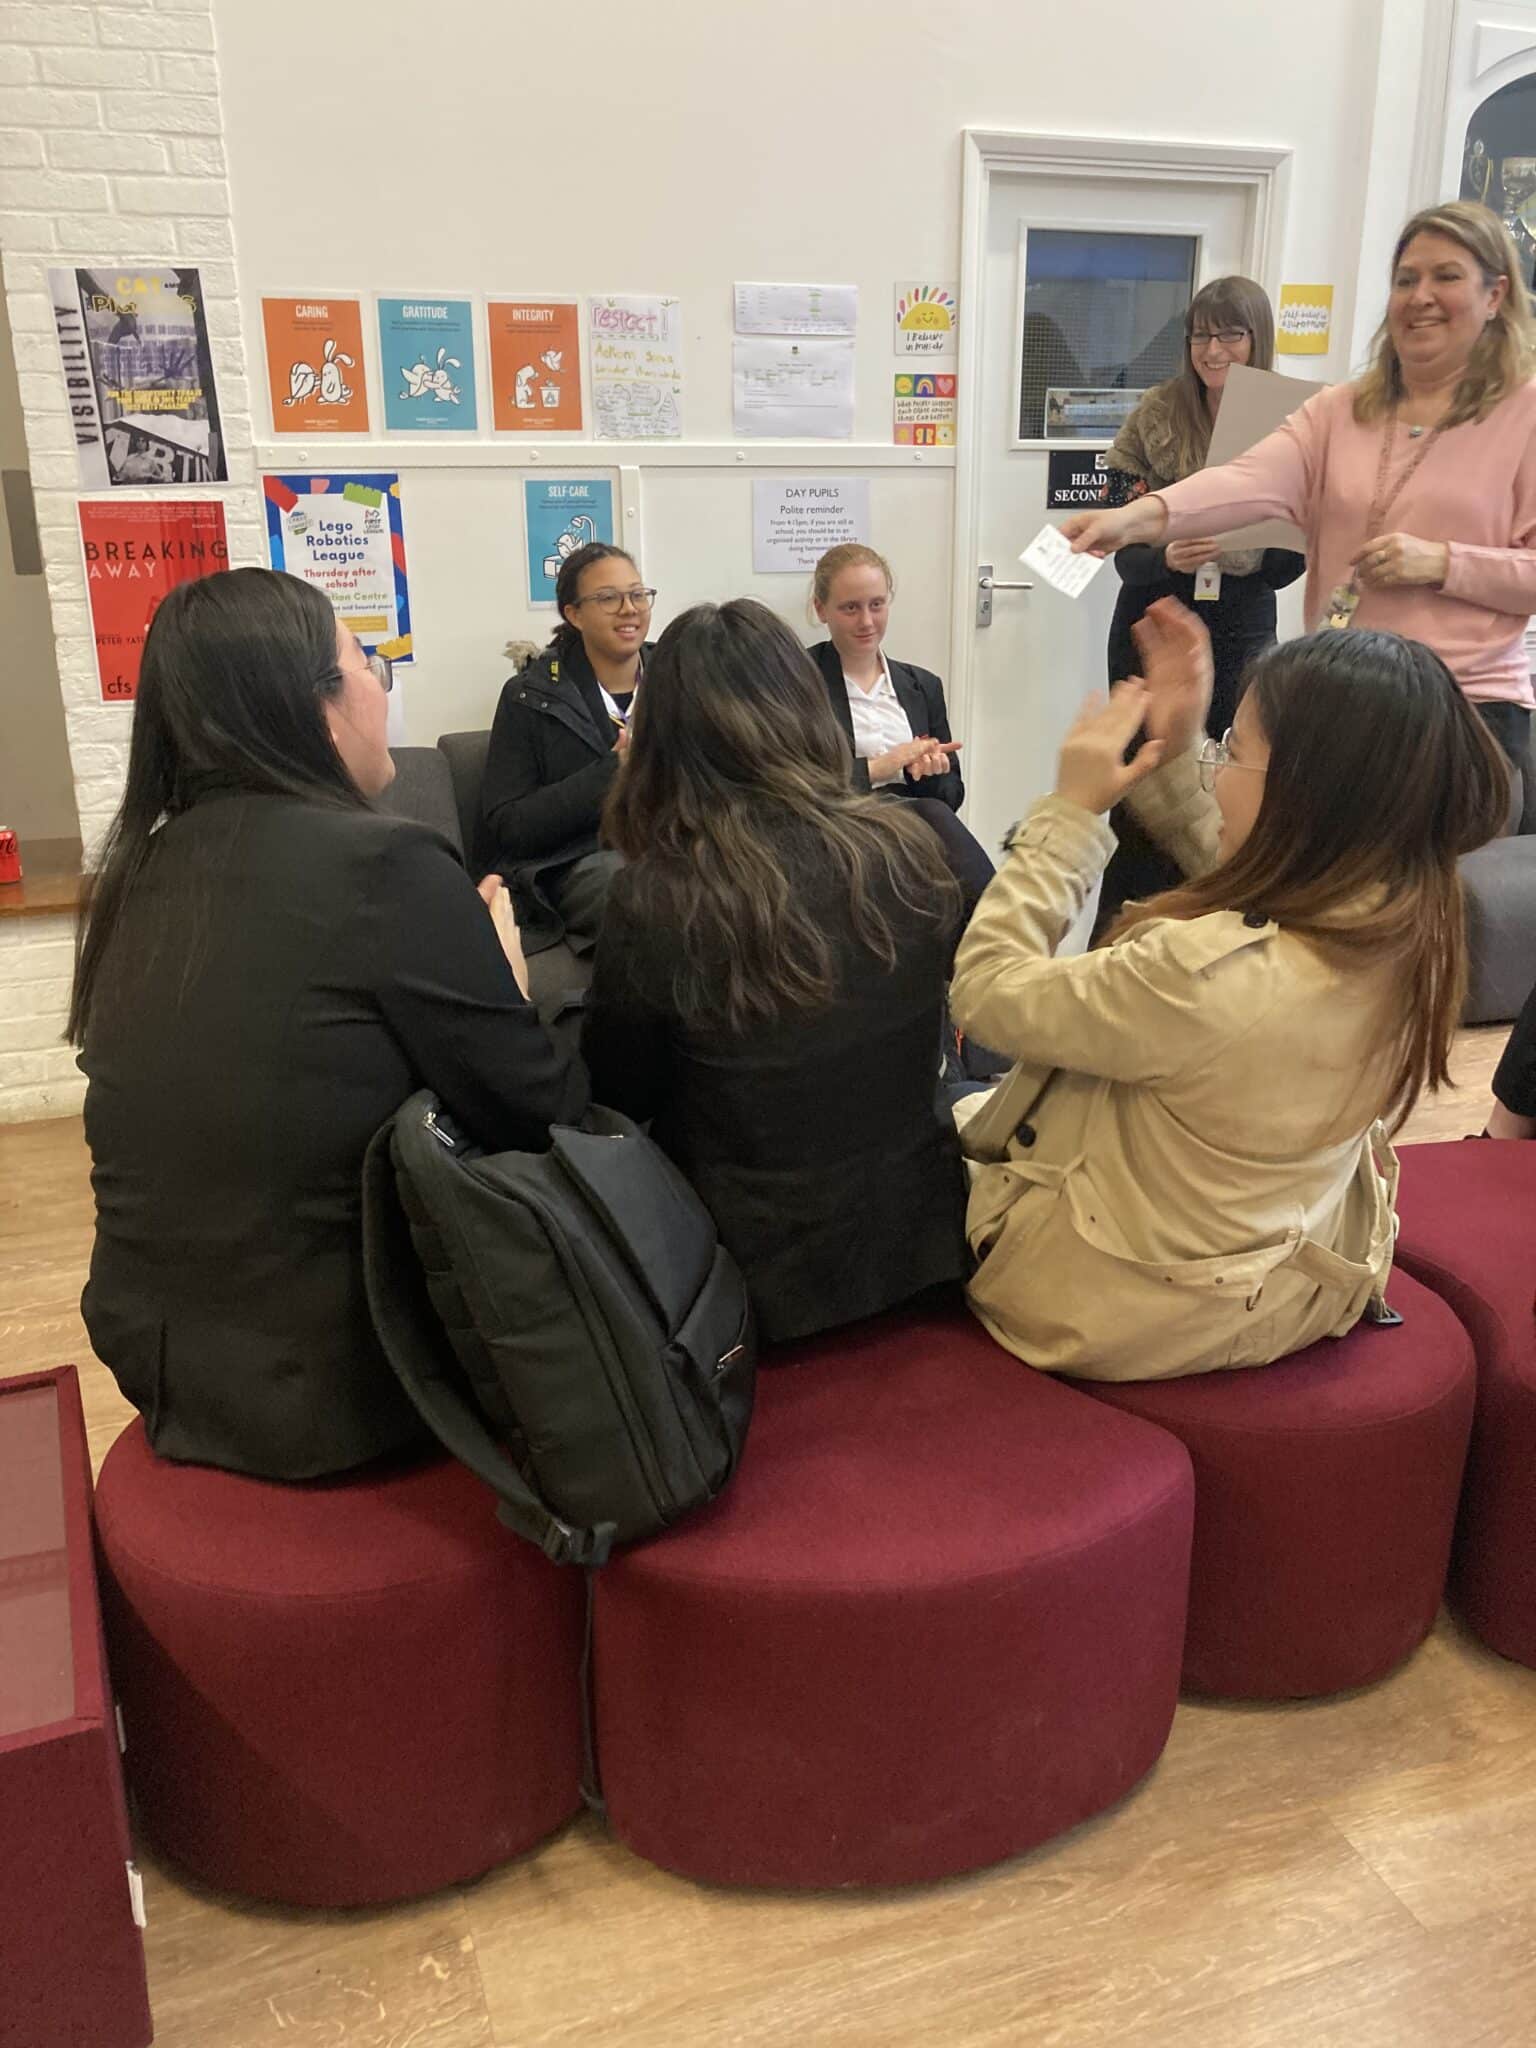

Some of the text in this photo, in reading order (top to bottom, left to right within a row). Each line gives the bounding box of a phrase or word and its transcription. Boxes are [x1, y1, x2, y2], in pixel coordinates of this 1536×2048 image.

[295, 305, 328, 318] CARING
[402, 305, 448, 319] GRATITUDE
[512, 308, 554, 322] INTEGRITY
[54, 305, 99, 445] VISIBILITY
[1071, 474, 1108, 486] HEAD
[548, 486, 590, 497] SELF-CARE
[785, 488, 840, 498] DAY PUPILS
[780, 505, 844, 515] Polite reminder
[319, 520, 353, 535] Lego
[306, 534, 369, 547] Robotics
[84, 541, 228, 561] BREAKING
[313, 550, 365, 564] League
[89, 562, 157, 579] AWAY
[304, 568, 377, 579] Thursday after
[326, 579, 358, 589] school
[354, 592, 388, 601] Centre
[107, 675, 132, 694] cfs
